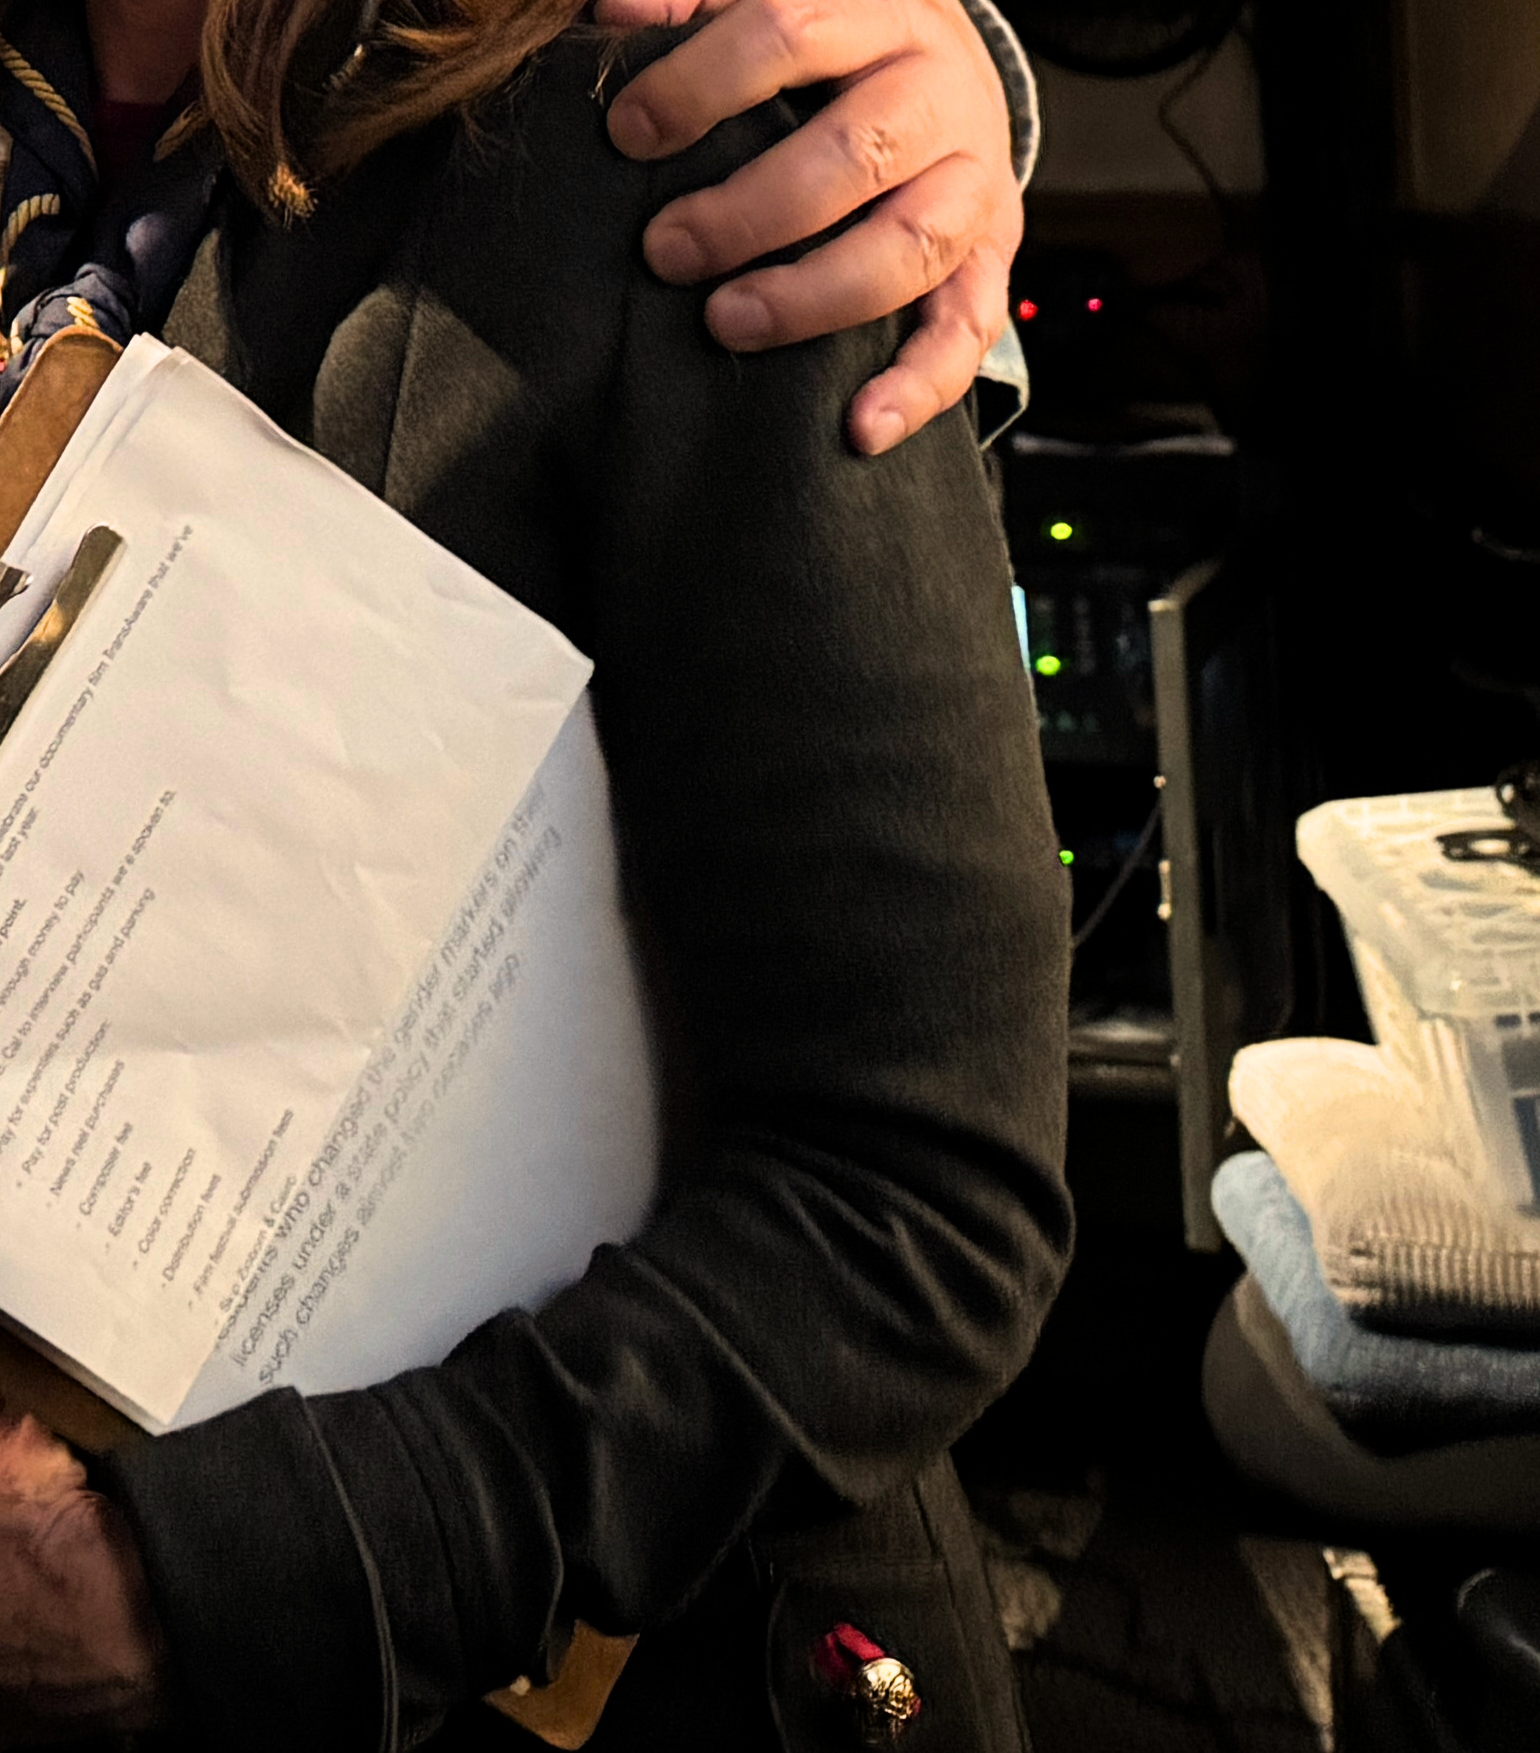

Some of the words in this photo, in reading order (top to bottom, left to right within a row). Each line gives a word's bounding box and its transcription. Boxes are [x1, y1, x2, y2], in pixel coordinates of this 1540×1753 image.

[23, 768, 41, 793] our
[38, 687, 94, 769] documentary
[86, 660, 108, 686] film
[101, 588, 153, 660] TransAware
[146, 561, 170, 589] that
[165, 523, 193, 563] we've
[0, 1035, 23, 1060] Cal
[16, 1019, 32, 1037] to
[64, 886, 115, 965] participants
[130, 805, 164, 855] spoken
[26, 910, 61, 957] money
[52, 894, 70, 911] to
[64, 869, 85, 897] pay
[6, 1104, 24, 1126] for
[19, 1041, 60, 1104] expenses
[54, 1007, 80, 1041] such
[77, 991, 92, 1009] as
[87, 964, 109, 992] gas
[104, 934, 125, 965] and
[119, 886, 156, 939] parking
[20, 1146, 45, 1175] Pay
[35, 1123, 53, 1146] for
[47, 1091, 69, 1127] post
[48, 1157, 76, 1197] News
[70, 1127, 90, 1156] reel
[77, 1145, 120, 1216] Composer
[114, 1121, 133, 1143] fee
[106, 1184, 141, 1238] Editor's
[133, 1160, 152, 1182] fee
[273, 1189, 311, 1239] who
[306, 1084, 371, 1187] changed
[136, 1215, 162, 1255] Color
[158, 1146, 196, 1216] correction
[160, 1203, 205, 1282] Distribution
[199, 1173, 221, 1202] fees
[191, 1262, 214, 1296] Film
[232, 1138, 277, 1215] submission
[271, 1109, 294, 1137] fees
[229, 1273, 296, 1368] licenses
[290, 1198, 337, 1271] under
[334, 1181, 351, 1201] a
[257, 1327, 299, 1381] such
[294, 1226, 360, 1326] changes
